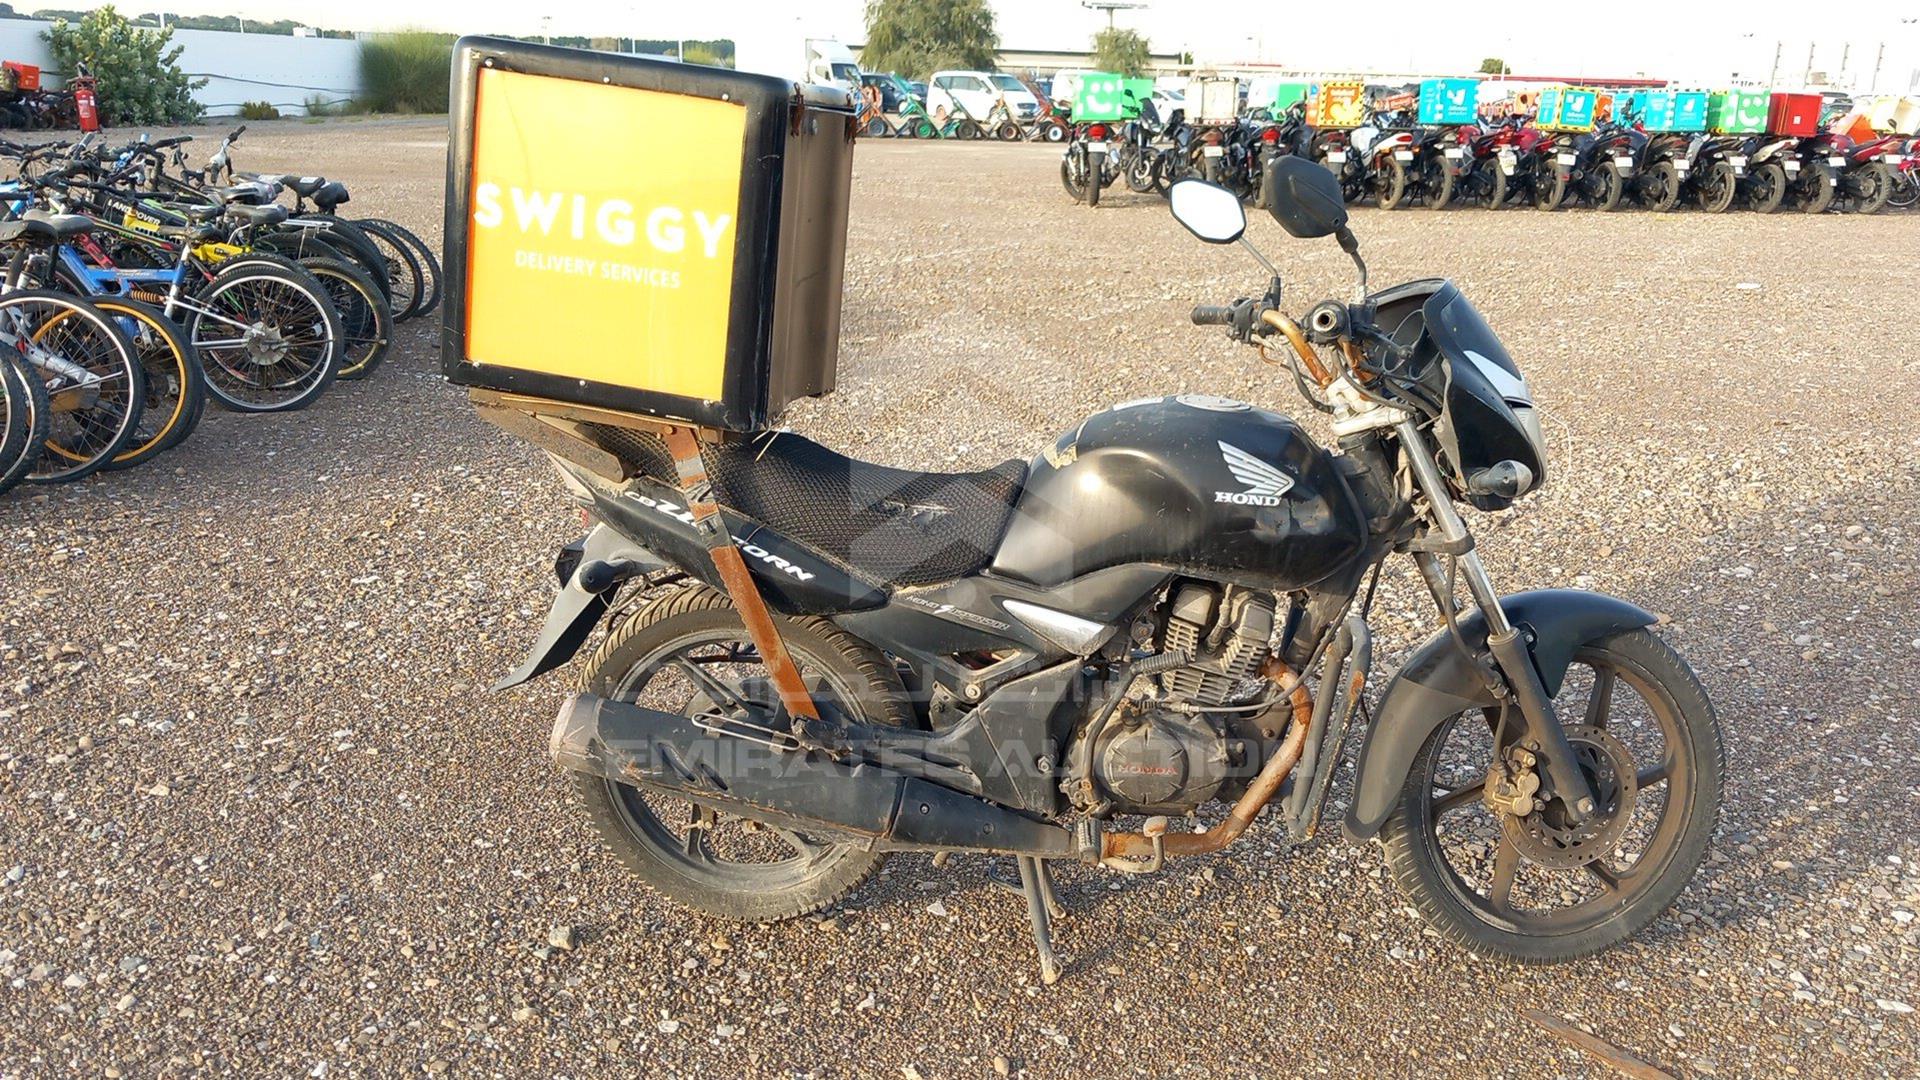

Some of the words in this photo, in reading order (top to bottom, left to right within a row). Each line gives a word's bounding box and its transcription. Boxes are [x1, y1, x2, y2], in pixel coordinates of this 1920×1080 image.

[135, 210, 161, 226] OVER
[474, 181, 731, 259] SWIGGY
[515, 249, 595, 277] DELIVERY
[600, 261, 681, 289] SERVICES
[655, 499, 816, 582] UORN
